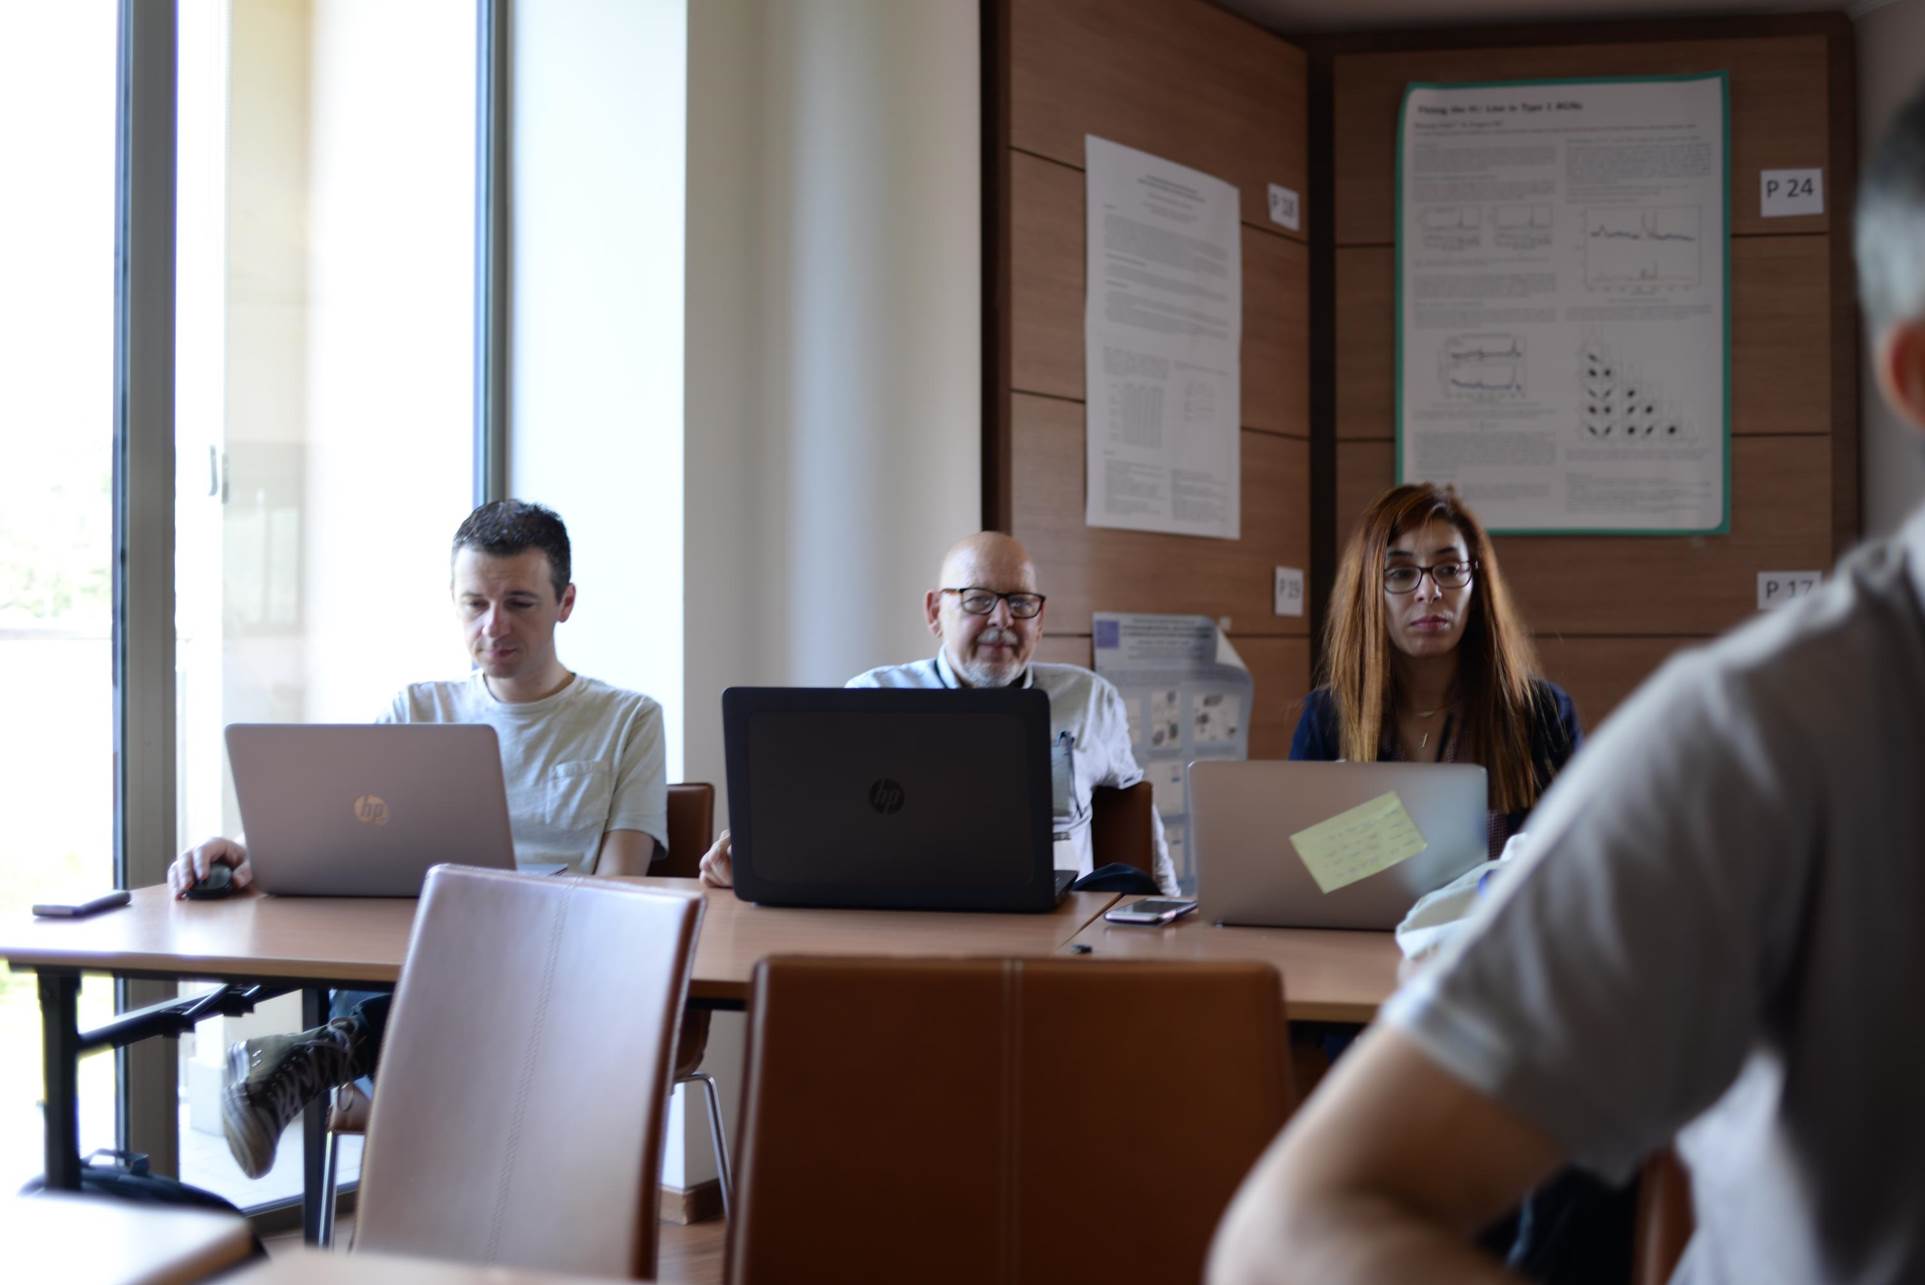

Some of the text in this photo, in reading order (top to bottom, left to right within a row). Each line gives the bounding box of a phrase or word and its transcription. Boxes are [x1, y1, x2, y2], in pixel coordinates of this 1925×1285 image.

[1766, 177, 1814, 198] P 24
[1766, 579, 1814, 599] P 17
[873, 778, 900, 814] hp
[358, 795, 388, 826] hp
